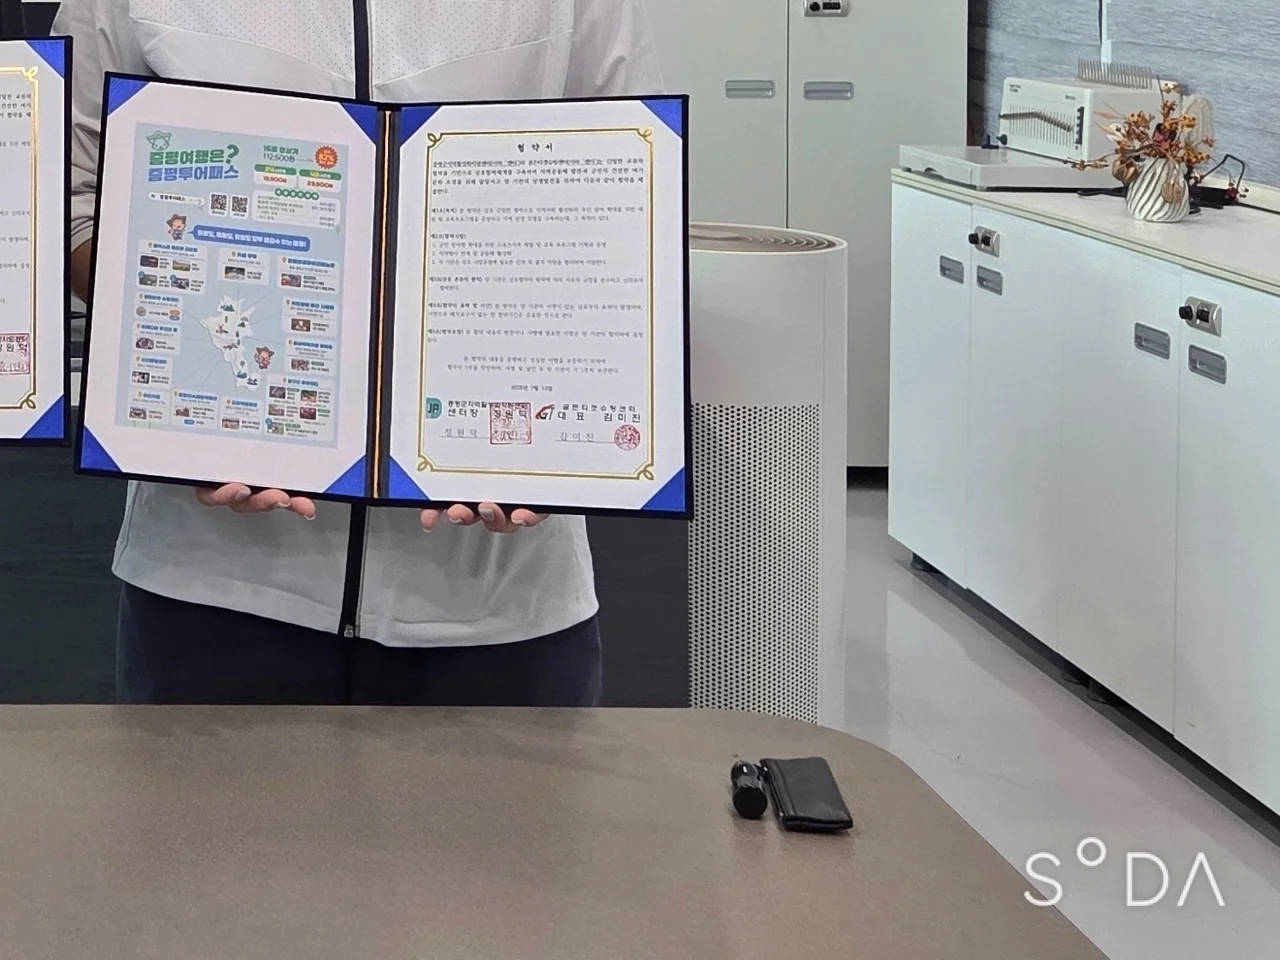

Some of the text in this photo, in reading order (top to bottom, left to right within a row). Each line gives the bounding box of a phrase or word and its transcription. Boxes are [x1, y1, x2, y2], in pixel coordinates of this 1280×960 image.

[149, 144, 239, 165] 증평여행은?
[264, 153, 295, 162] 112,500원
[148, 165, 239, 182] 증평투어패스
[448, 409, 478, 417] 센터장
[604, 413, 640, 423] 김미진
